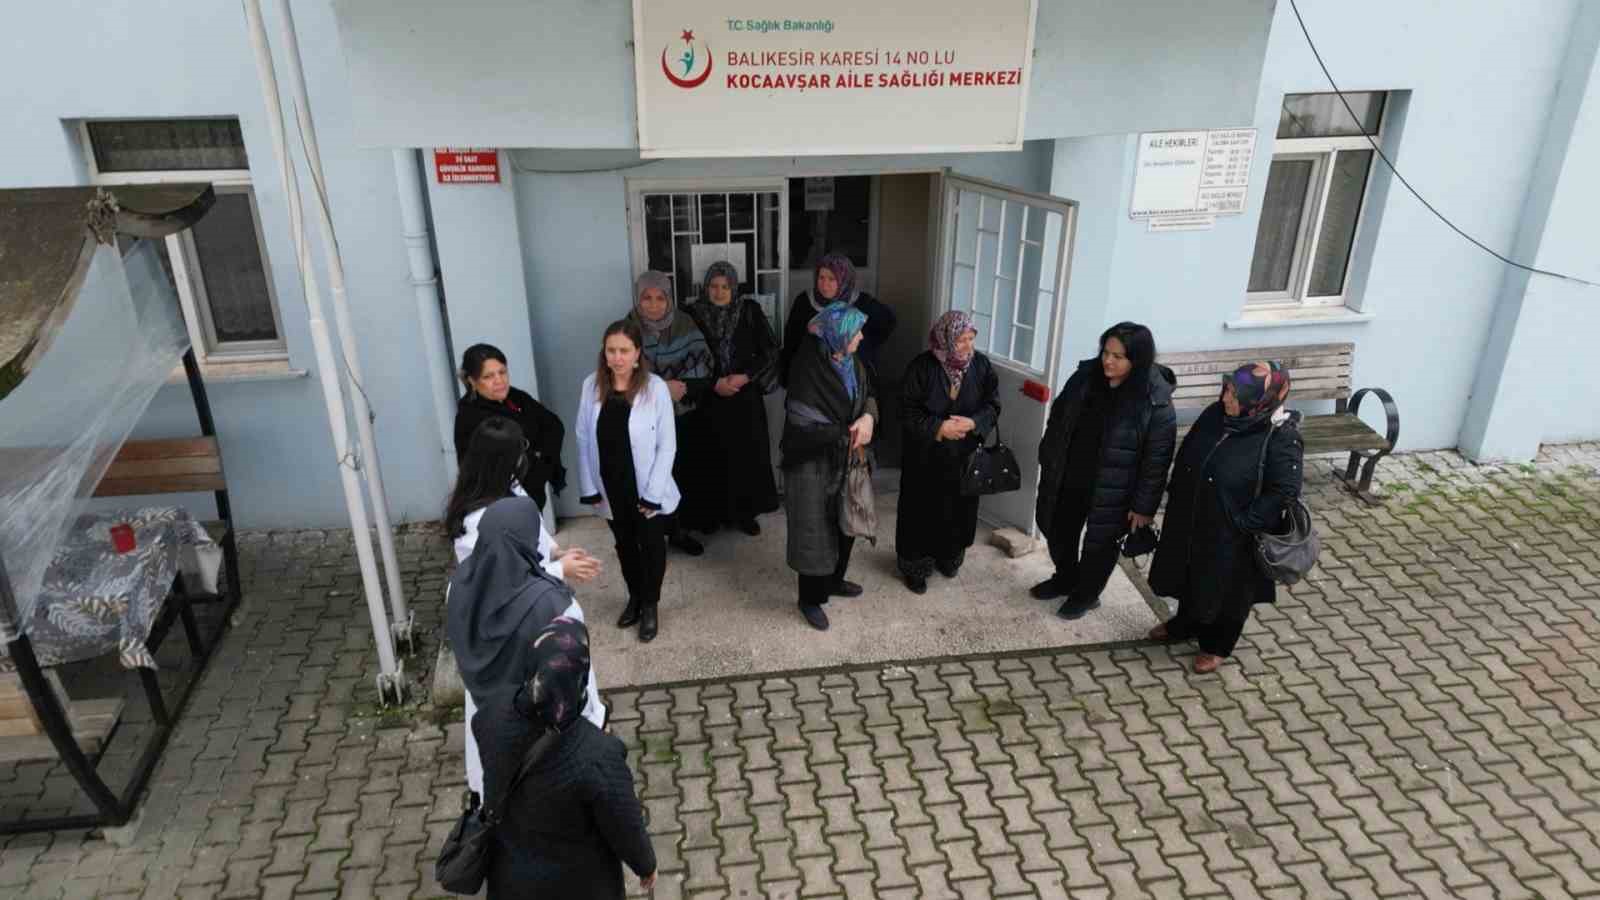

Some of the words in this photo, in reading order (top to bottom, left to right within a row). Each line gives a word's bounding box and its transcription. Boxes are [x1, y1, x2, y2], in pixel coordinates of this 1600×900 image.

[746, 19, 780, 33] Sağlık
[783, 19, 835, 34] Bakanlığı
[727, 48, 815, 66] BALIKESİR
[820, 47, 880, 66] KARESİ
[885, 49, 902, 65] 14
[906, 49, 929, 65] NO
[934, 49, 955, 65] LU
[727, 74, 831, 93] KOCAAVŞAR
[835, 69, 874, 89] AİLE
[878, 69, 945, 88] SAĞLIĞI
[948, 67, 1022, 86] MERKEZİ
